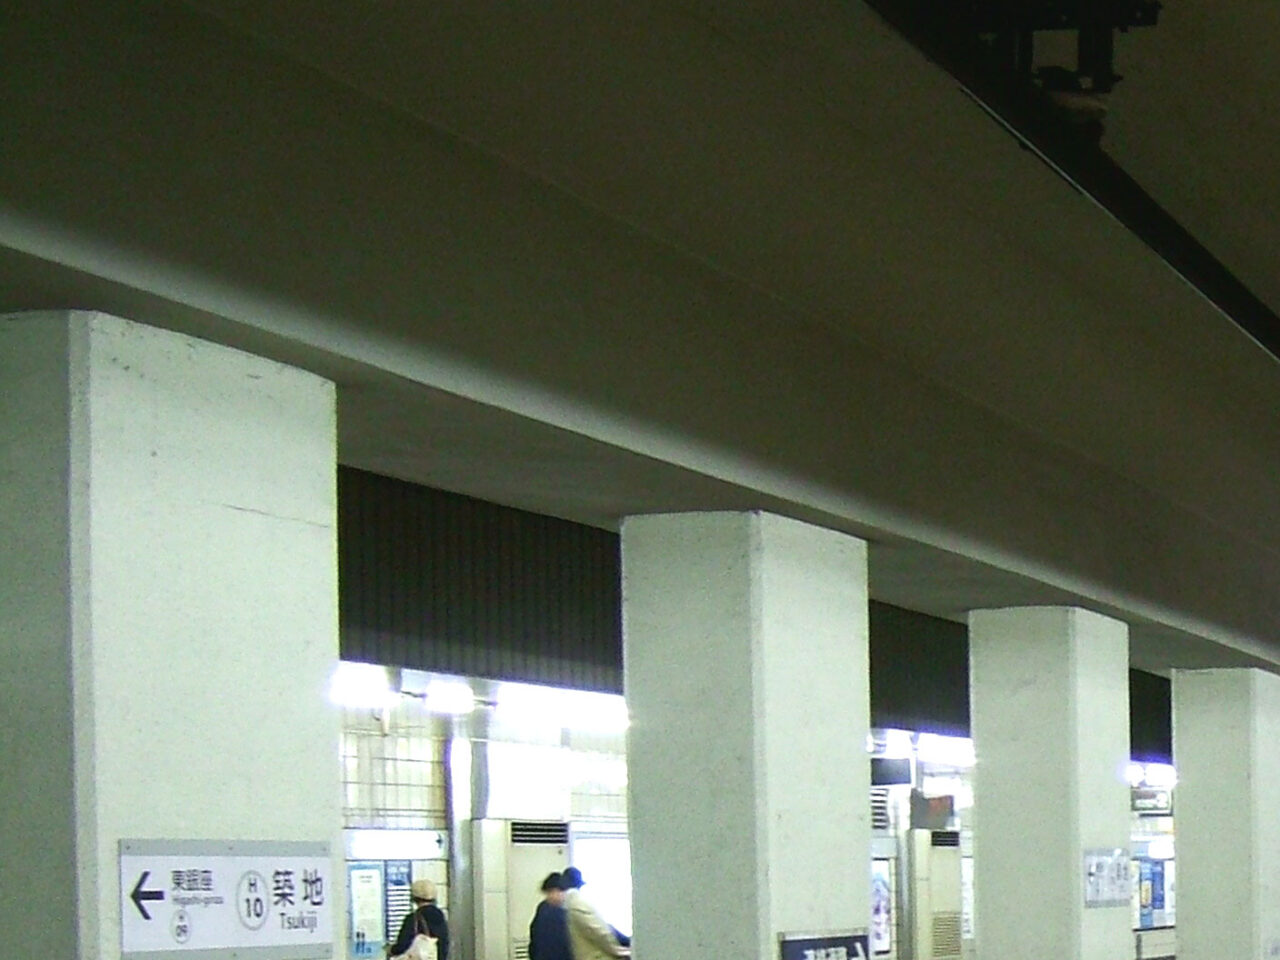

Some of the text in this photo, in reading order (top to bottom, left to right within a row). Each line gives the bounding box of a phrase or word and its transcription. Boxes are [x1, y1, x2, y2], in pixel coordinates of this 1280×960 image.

[248, 877, 258, 893] H
[272, 869, 324, 907] 築地
[245, 897, 264, 918] 10
